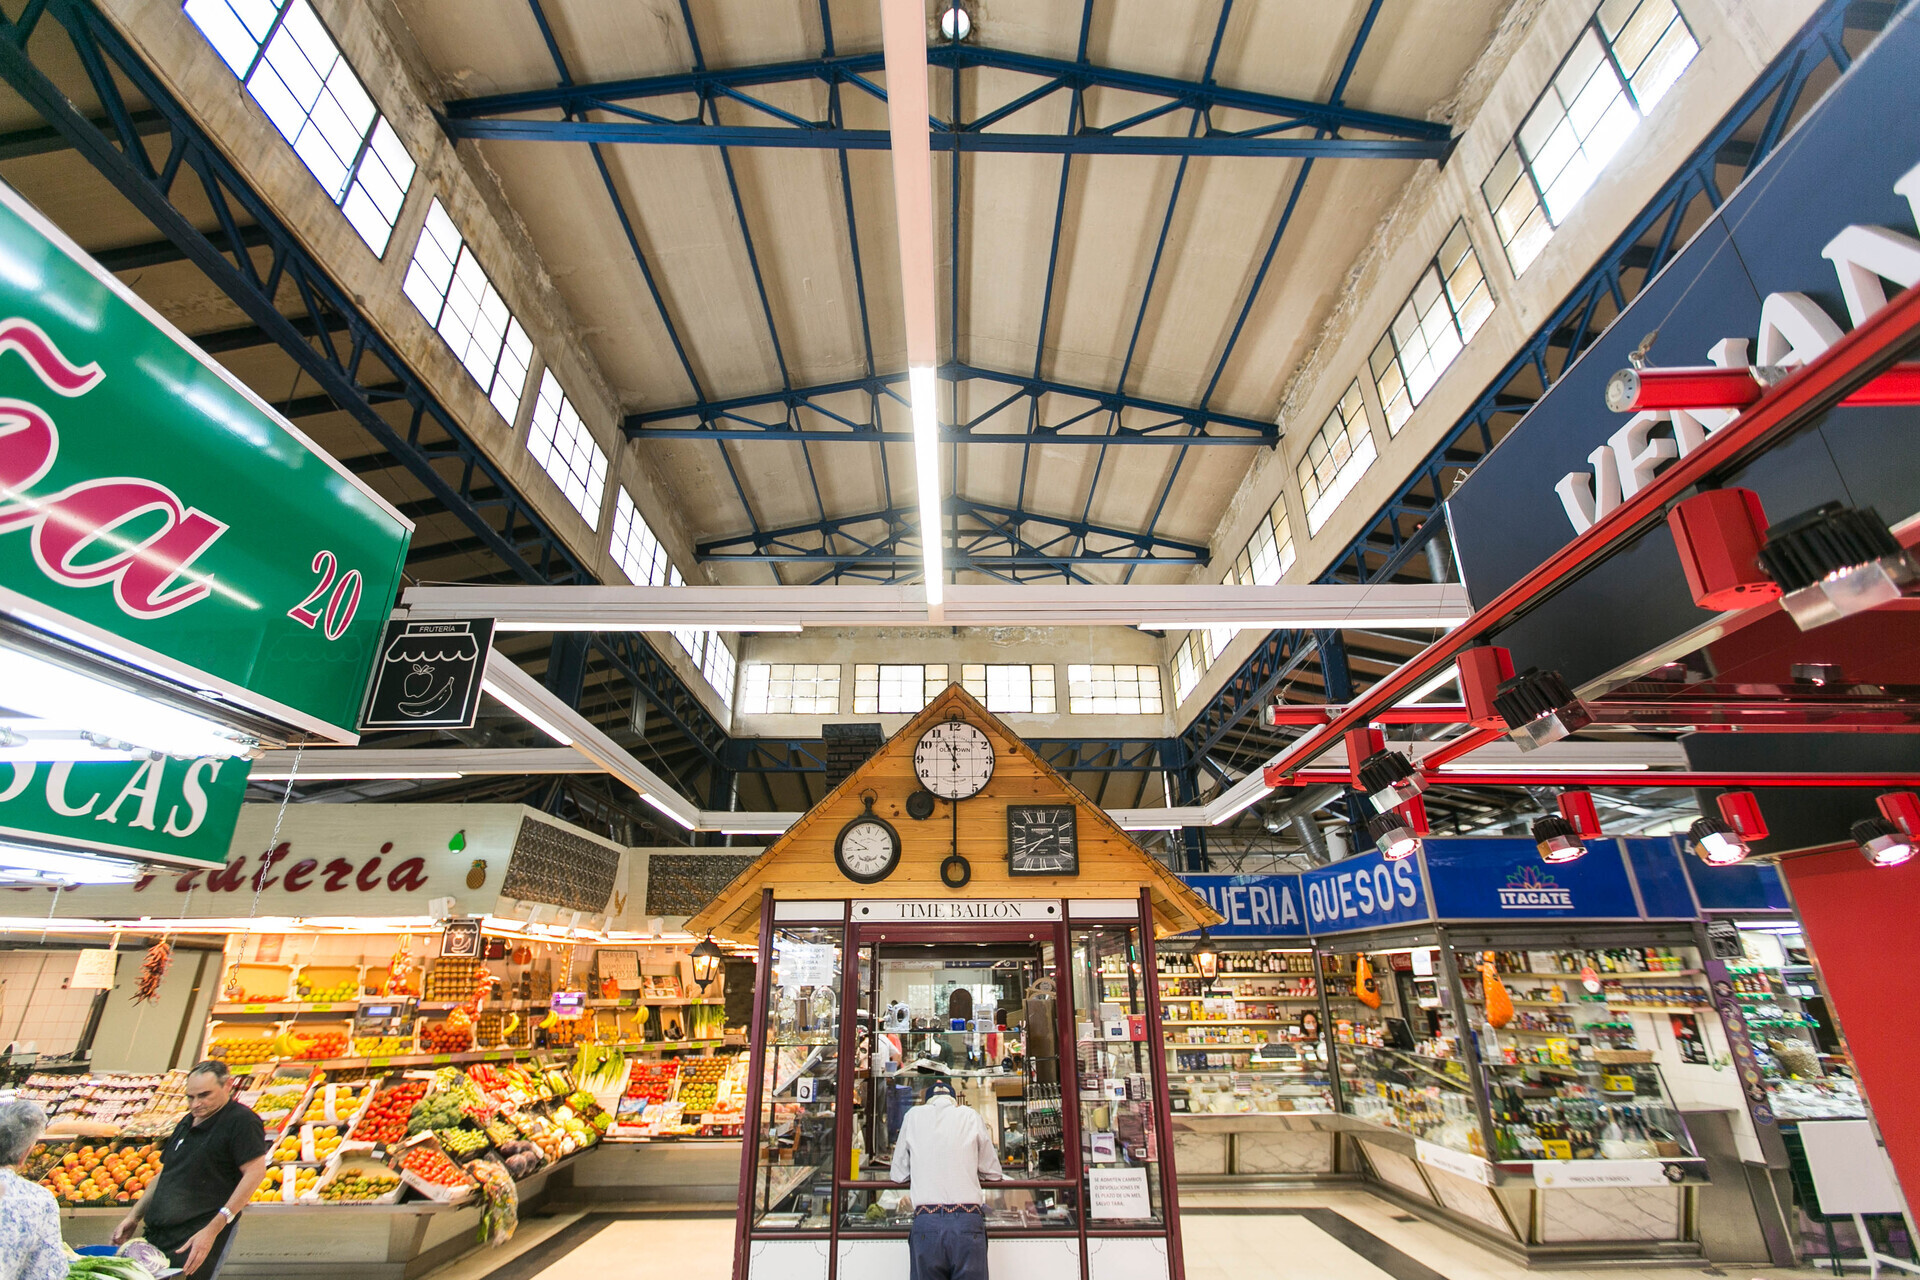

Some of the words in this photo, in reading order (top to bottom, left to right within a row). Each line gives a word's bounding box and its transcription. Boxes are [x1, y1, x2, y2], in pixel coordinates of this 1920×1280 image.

[287, 550, 363, 641] 20
[134, 842, 428, 893] ruteria
[1308, 859, 1417, 923] QUESOS
[897, 903, 944, 918] TIME
[1500, 892, 1572, 905] ITACATE
